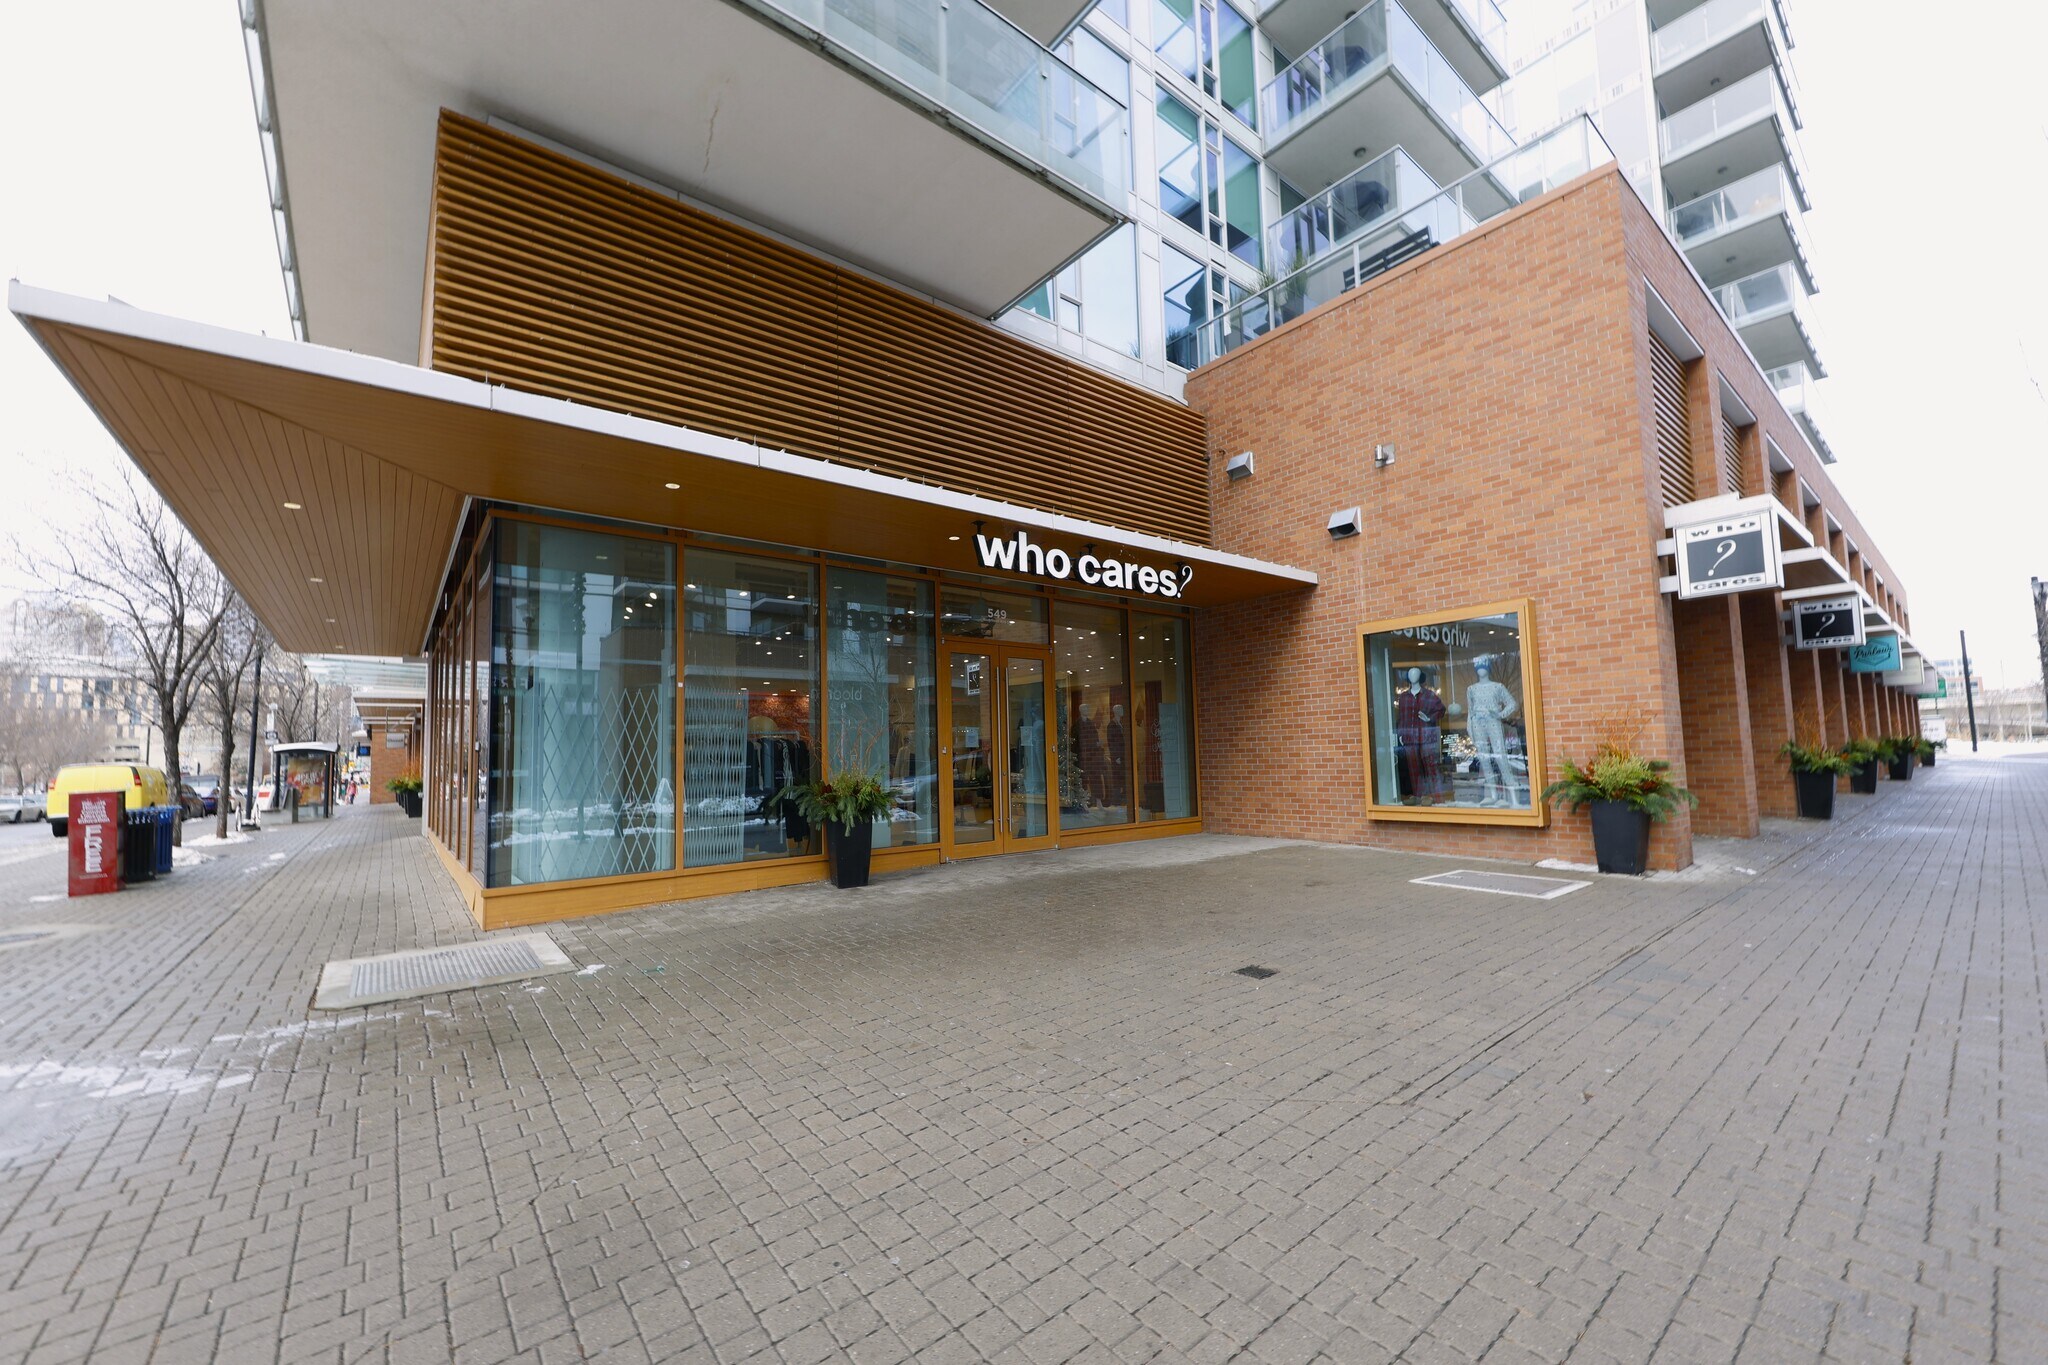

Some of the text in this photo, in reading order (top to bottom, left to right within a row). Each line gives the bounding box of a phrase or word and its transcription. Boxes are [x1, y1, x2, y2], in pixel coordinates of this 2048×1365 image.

[1691, 522, 1755, 537] who
[974, 531, 1193, 599] who cares?
[1693, 577, 1761, 590] cares
[987, 607, 1007, 620] 549
[1804, 602, 1848, 611] who
[84, 824, 103, 874] FREE
